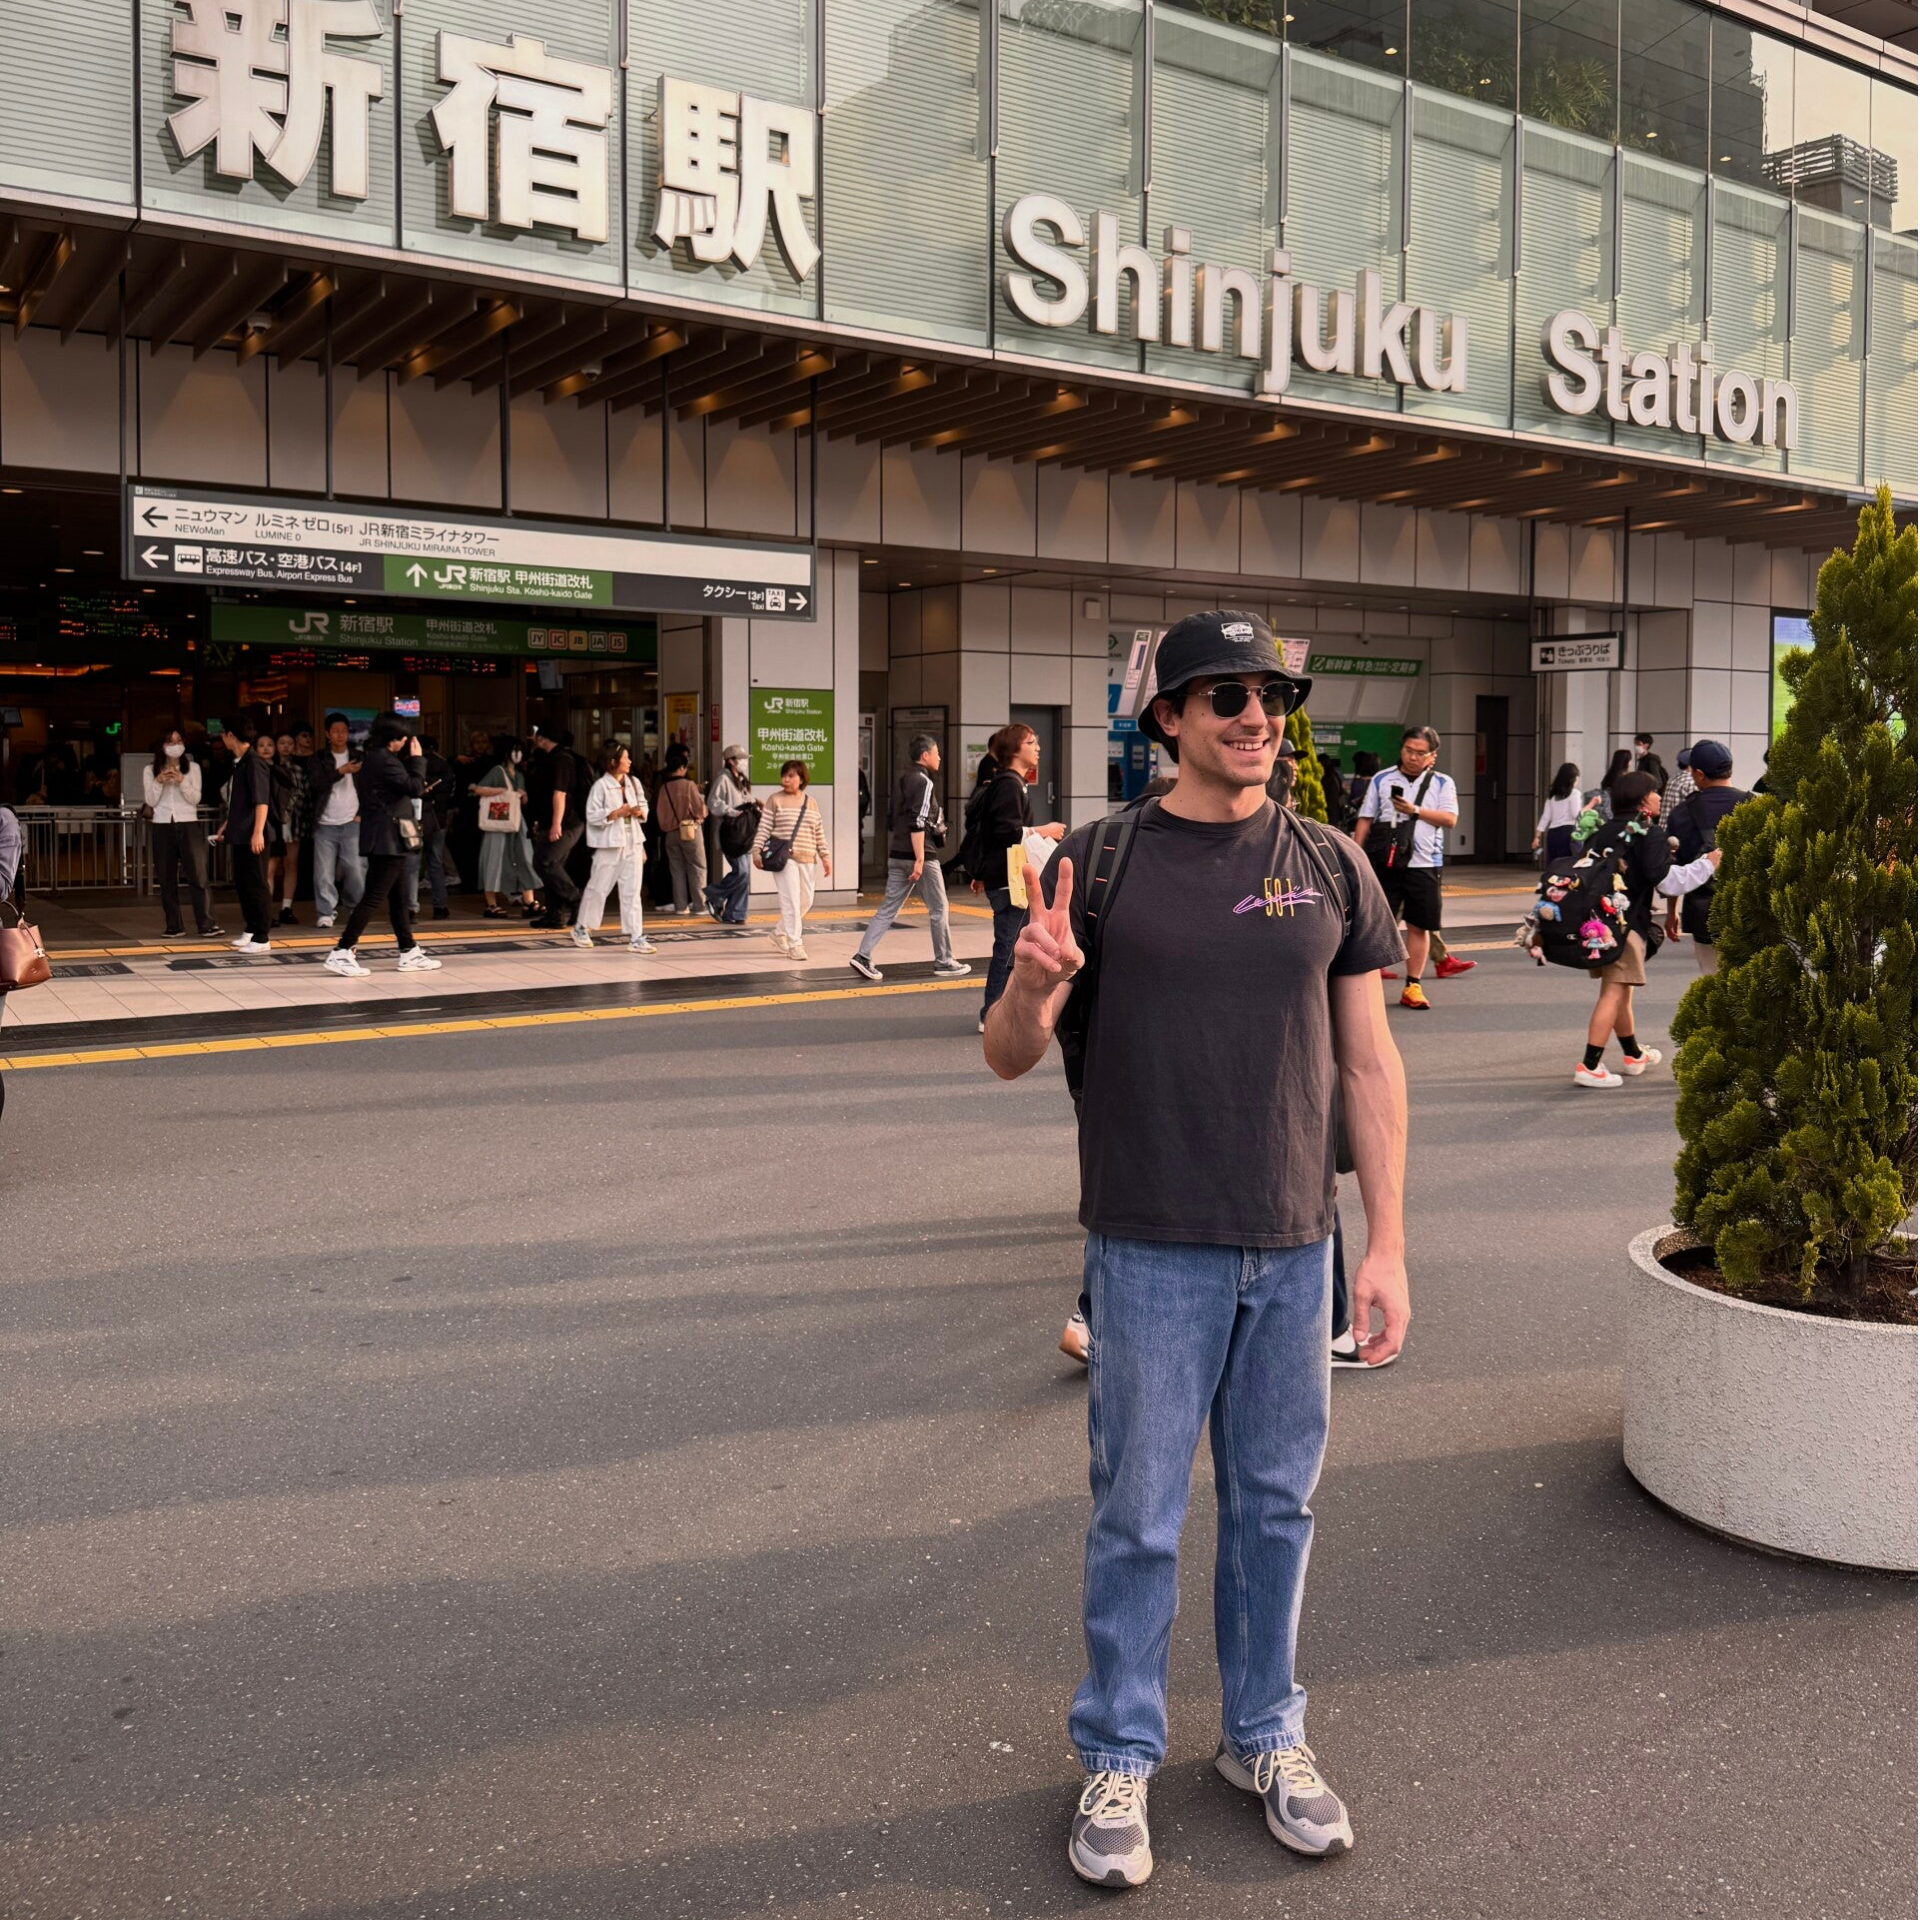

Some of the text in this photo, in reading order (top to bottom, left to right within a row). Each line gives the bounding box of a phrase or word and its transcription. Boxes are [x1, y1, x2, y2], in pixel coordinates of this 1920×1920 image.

[166, 0, 821, 282] 新宿駅
[1002, 193, 1798, 450] Shinjuku Station
[174, 507, 248, 525] ニュウマン
[360, 522, 500, 545] JR新宿ミライナタワー
[174, 524, 225, 536] NEWoMan
[255, 530, 293, 541] LUMINE
[359, 539, 372, 547] JR
[373, 540, 421, 551] SHINJUKU
[423, 543, 461, 554] MIRAINA
[463, 546, 496, 557] TOWER
[206, 565, 256, 580] Expressway
[277, 570, 303, 581] Airport
[304, 572, 336, 583] Express
[337, 573, 354, 583] Bus
[433, 564, 468, 584] JR
[469, 566, 593, 590] 新宿駅 甲州街道改札
[469, 583, 505, 595] Shinjuku
[506, 585, 523, 595] Sta.
[573, 589, 593, 600] Gate
[768, 589, 784, 597] TAXI
[751, 602, 765, 610] Taxi
[289, 611, 330, 634] JR
[340, 614, 394, 634] 新宿駅
[426, 618, 497, 635] 甲州街道改札
[340, 633, 382, 646] Shinjuku
[384, 635, 419, 647] Station
[1558, 642, 1610, 657] きっぷうりば
[764, 697, 784, 710] JR
[757, 727, 828, 742] 甲州街道改札
[807, 744, 824, 752] Gate
[1264, 878, 1295, 917] 501
